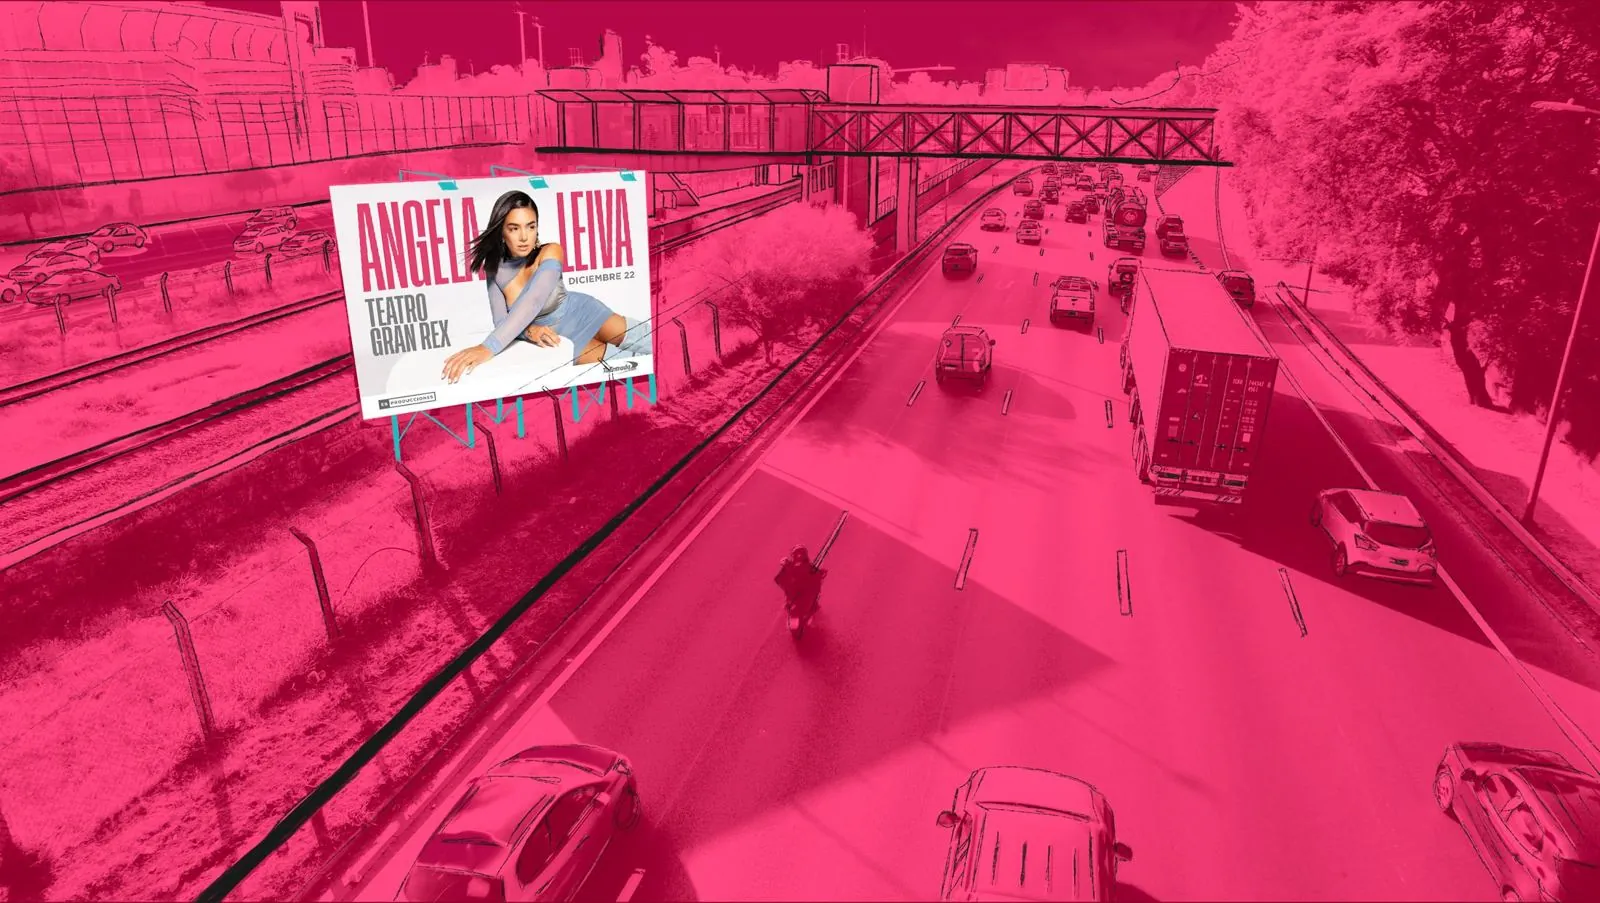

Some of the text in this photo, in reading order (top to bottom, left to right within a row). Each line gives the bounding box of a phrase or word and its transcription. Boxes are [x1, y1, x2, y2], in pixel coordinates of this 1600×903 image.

[357, 188, 633, 292] ANGELA LEIVA
[568, 271, 635, 285] DICIEMBRE 22
[365, 293, 428, 327] TEATRO
[370, 319, 451, 356] GRAN REX
